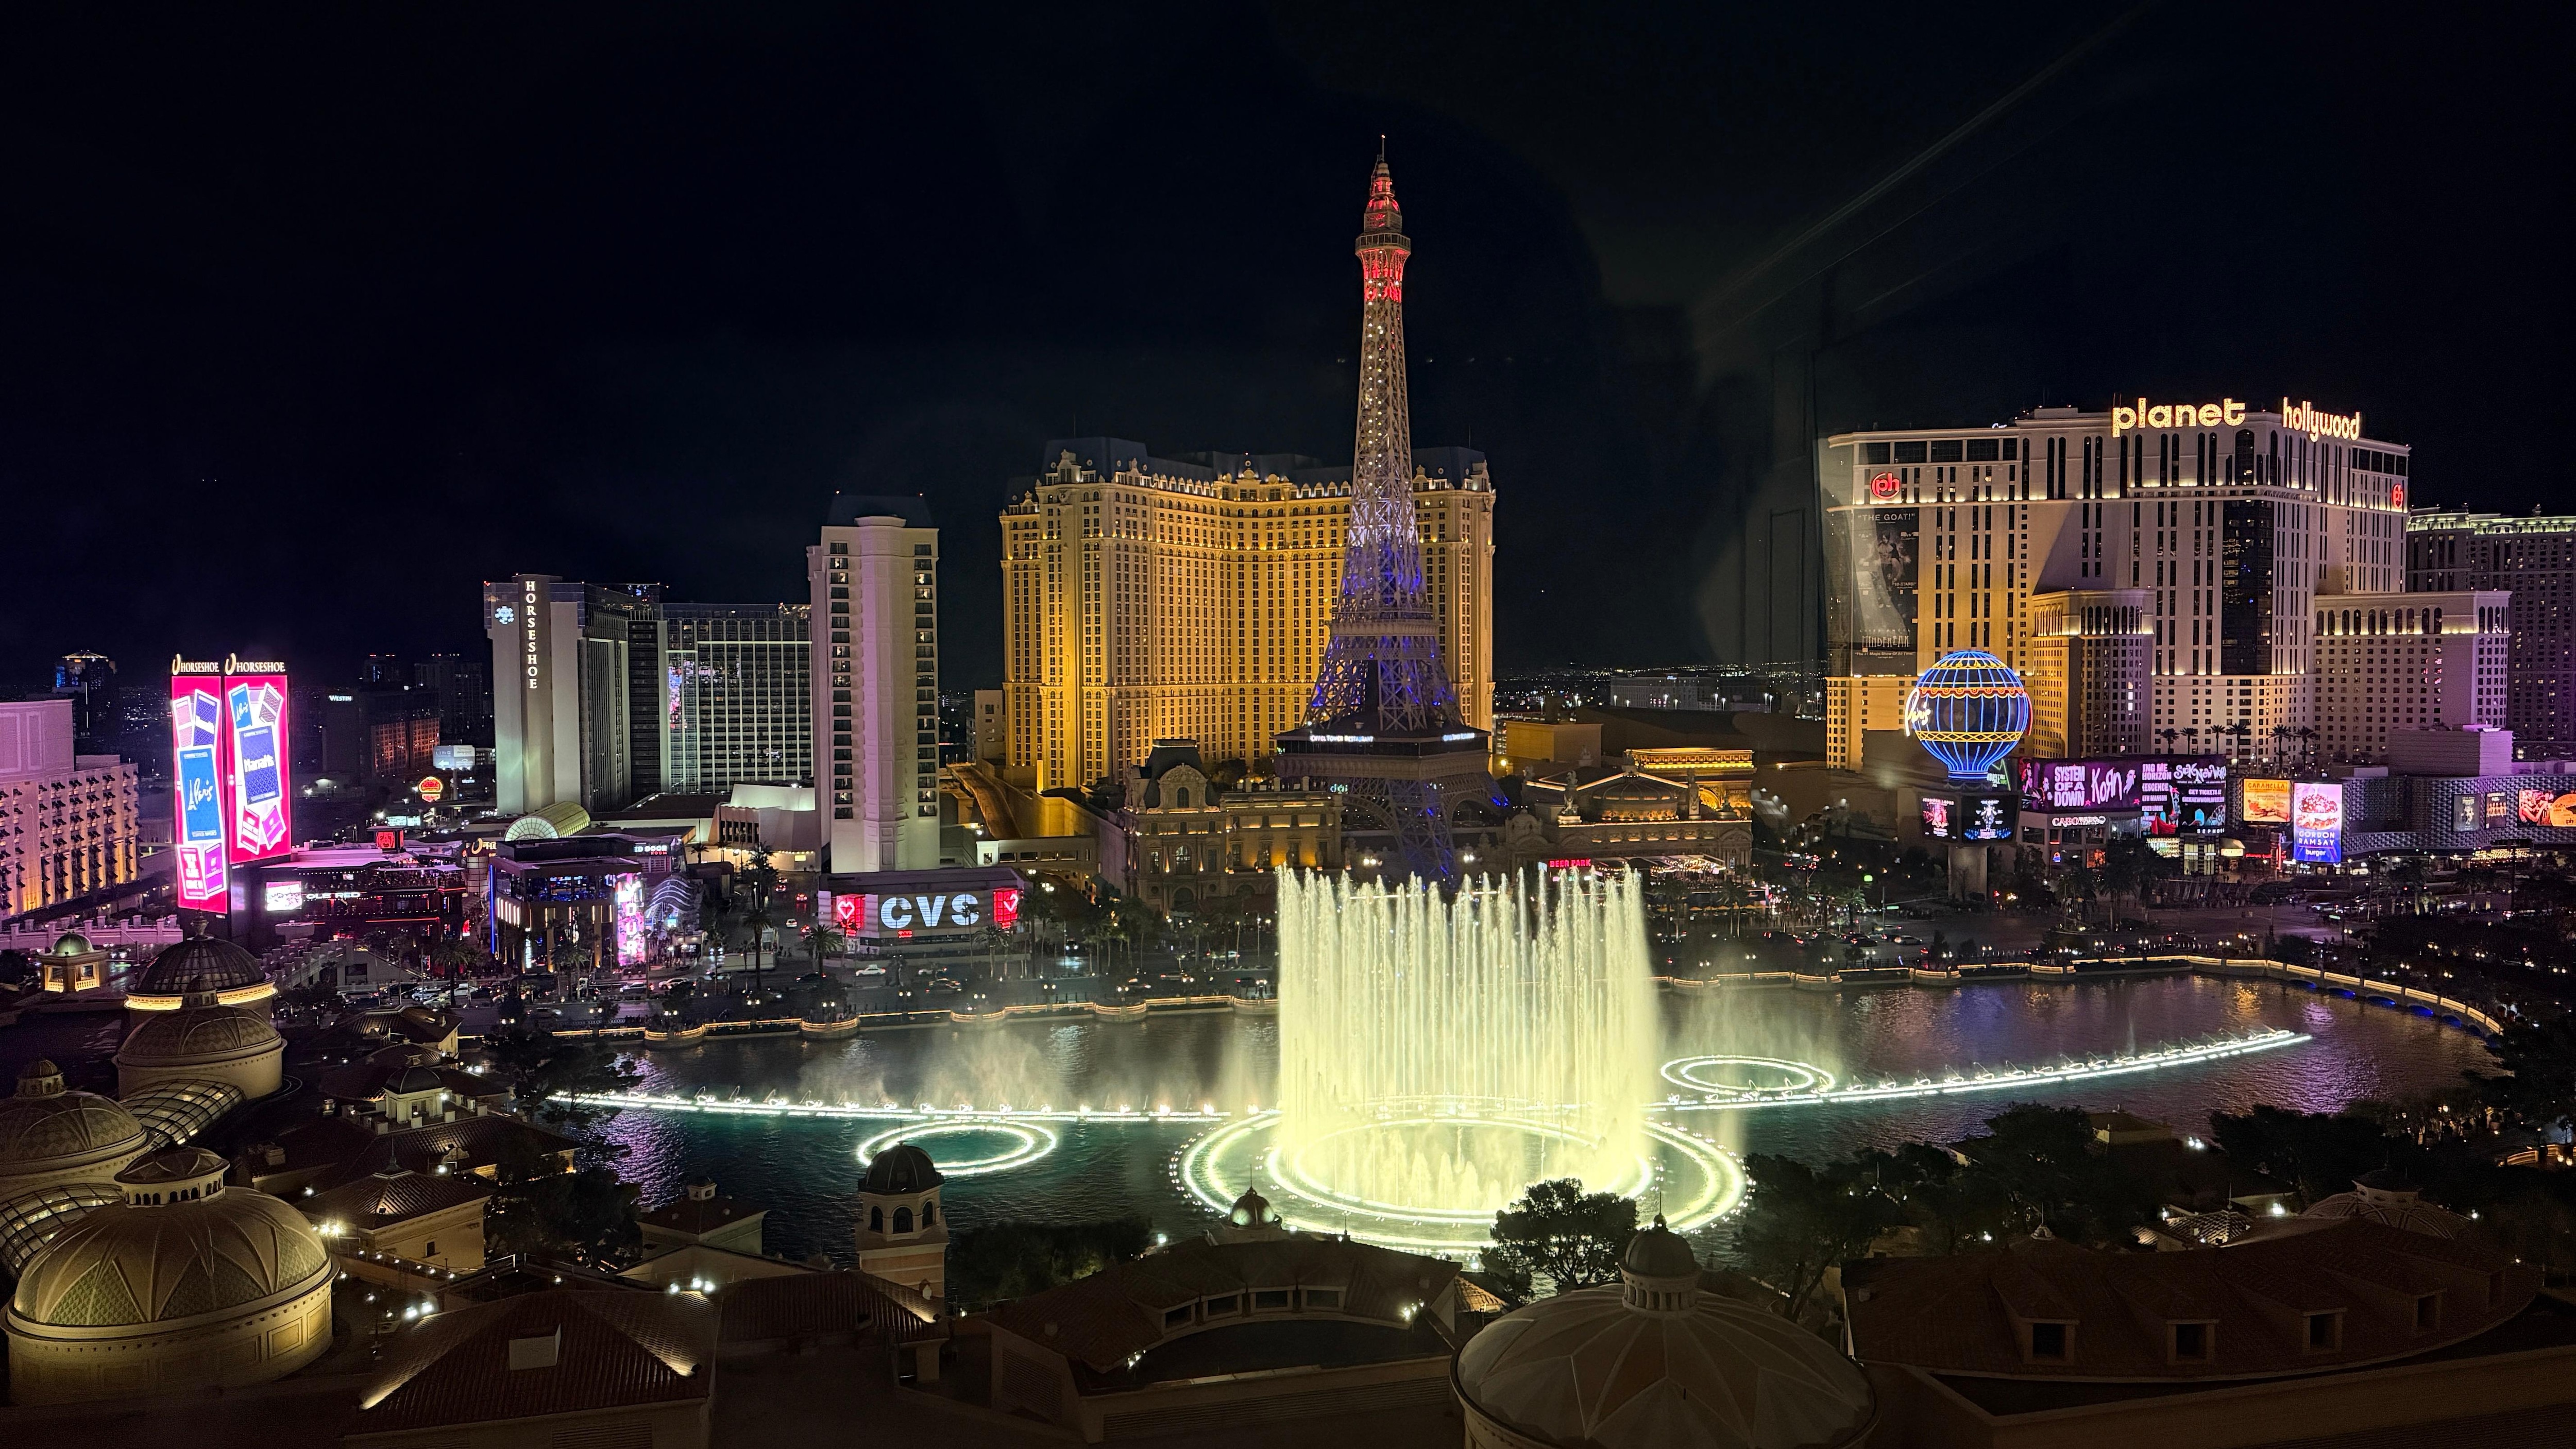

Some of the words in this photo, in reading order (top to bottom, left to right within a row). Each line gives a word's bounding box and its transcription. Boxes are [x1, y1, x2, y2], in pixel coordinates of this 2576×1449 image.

[2112, 398, 2246, 438] planet
[2283, 397, 2361, 442] hollywood
[526, 581, 538, 689] HORSESHOE
[181, 662, 219, 672] HORSESHOE
[236, 662, 286, 672] HORSESHOE
[1905, 688, 1931, 737] Paris
[2054, 765, 2086, 782] SYSTEM
[2142, 772, 2172, 780] HORIZON
[193, 777, 214, 805] Paris
[2054, 781, 2073, 791] OF
[2074, 781, 2085, 791] A
[2054, 791, 2085, 807] DOWN
[2299, 830, 2335, 839] GORDON
[2299, 838, 2335, 846] RAMSAY
[2306, 848, 2327, 857] burger
[880, 894, 979, 929] CVS
